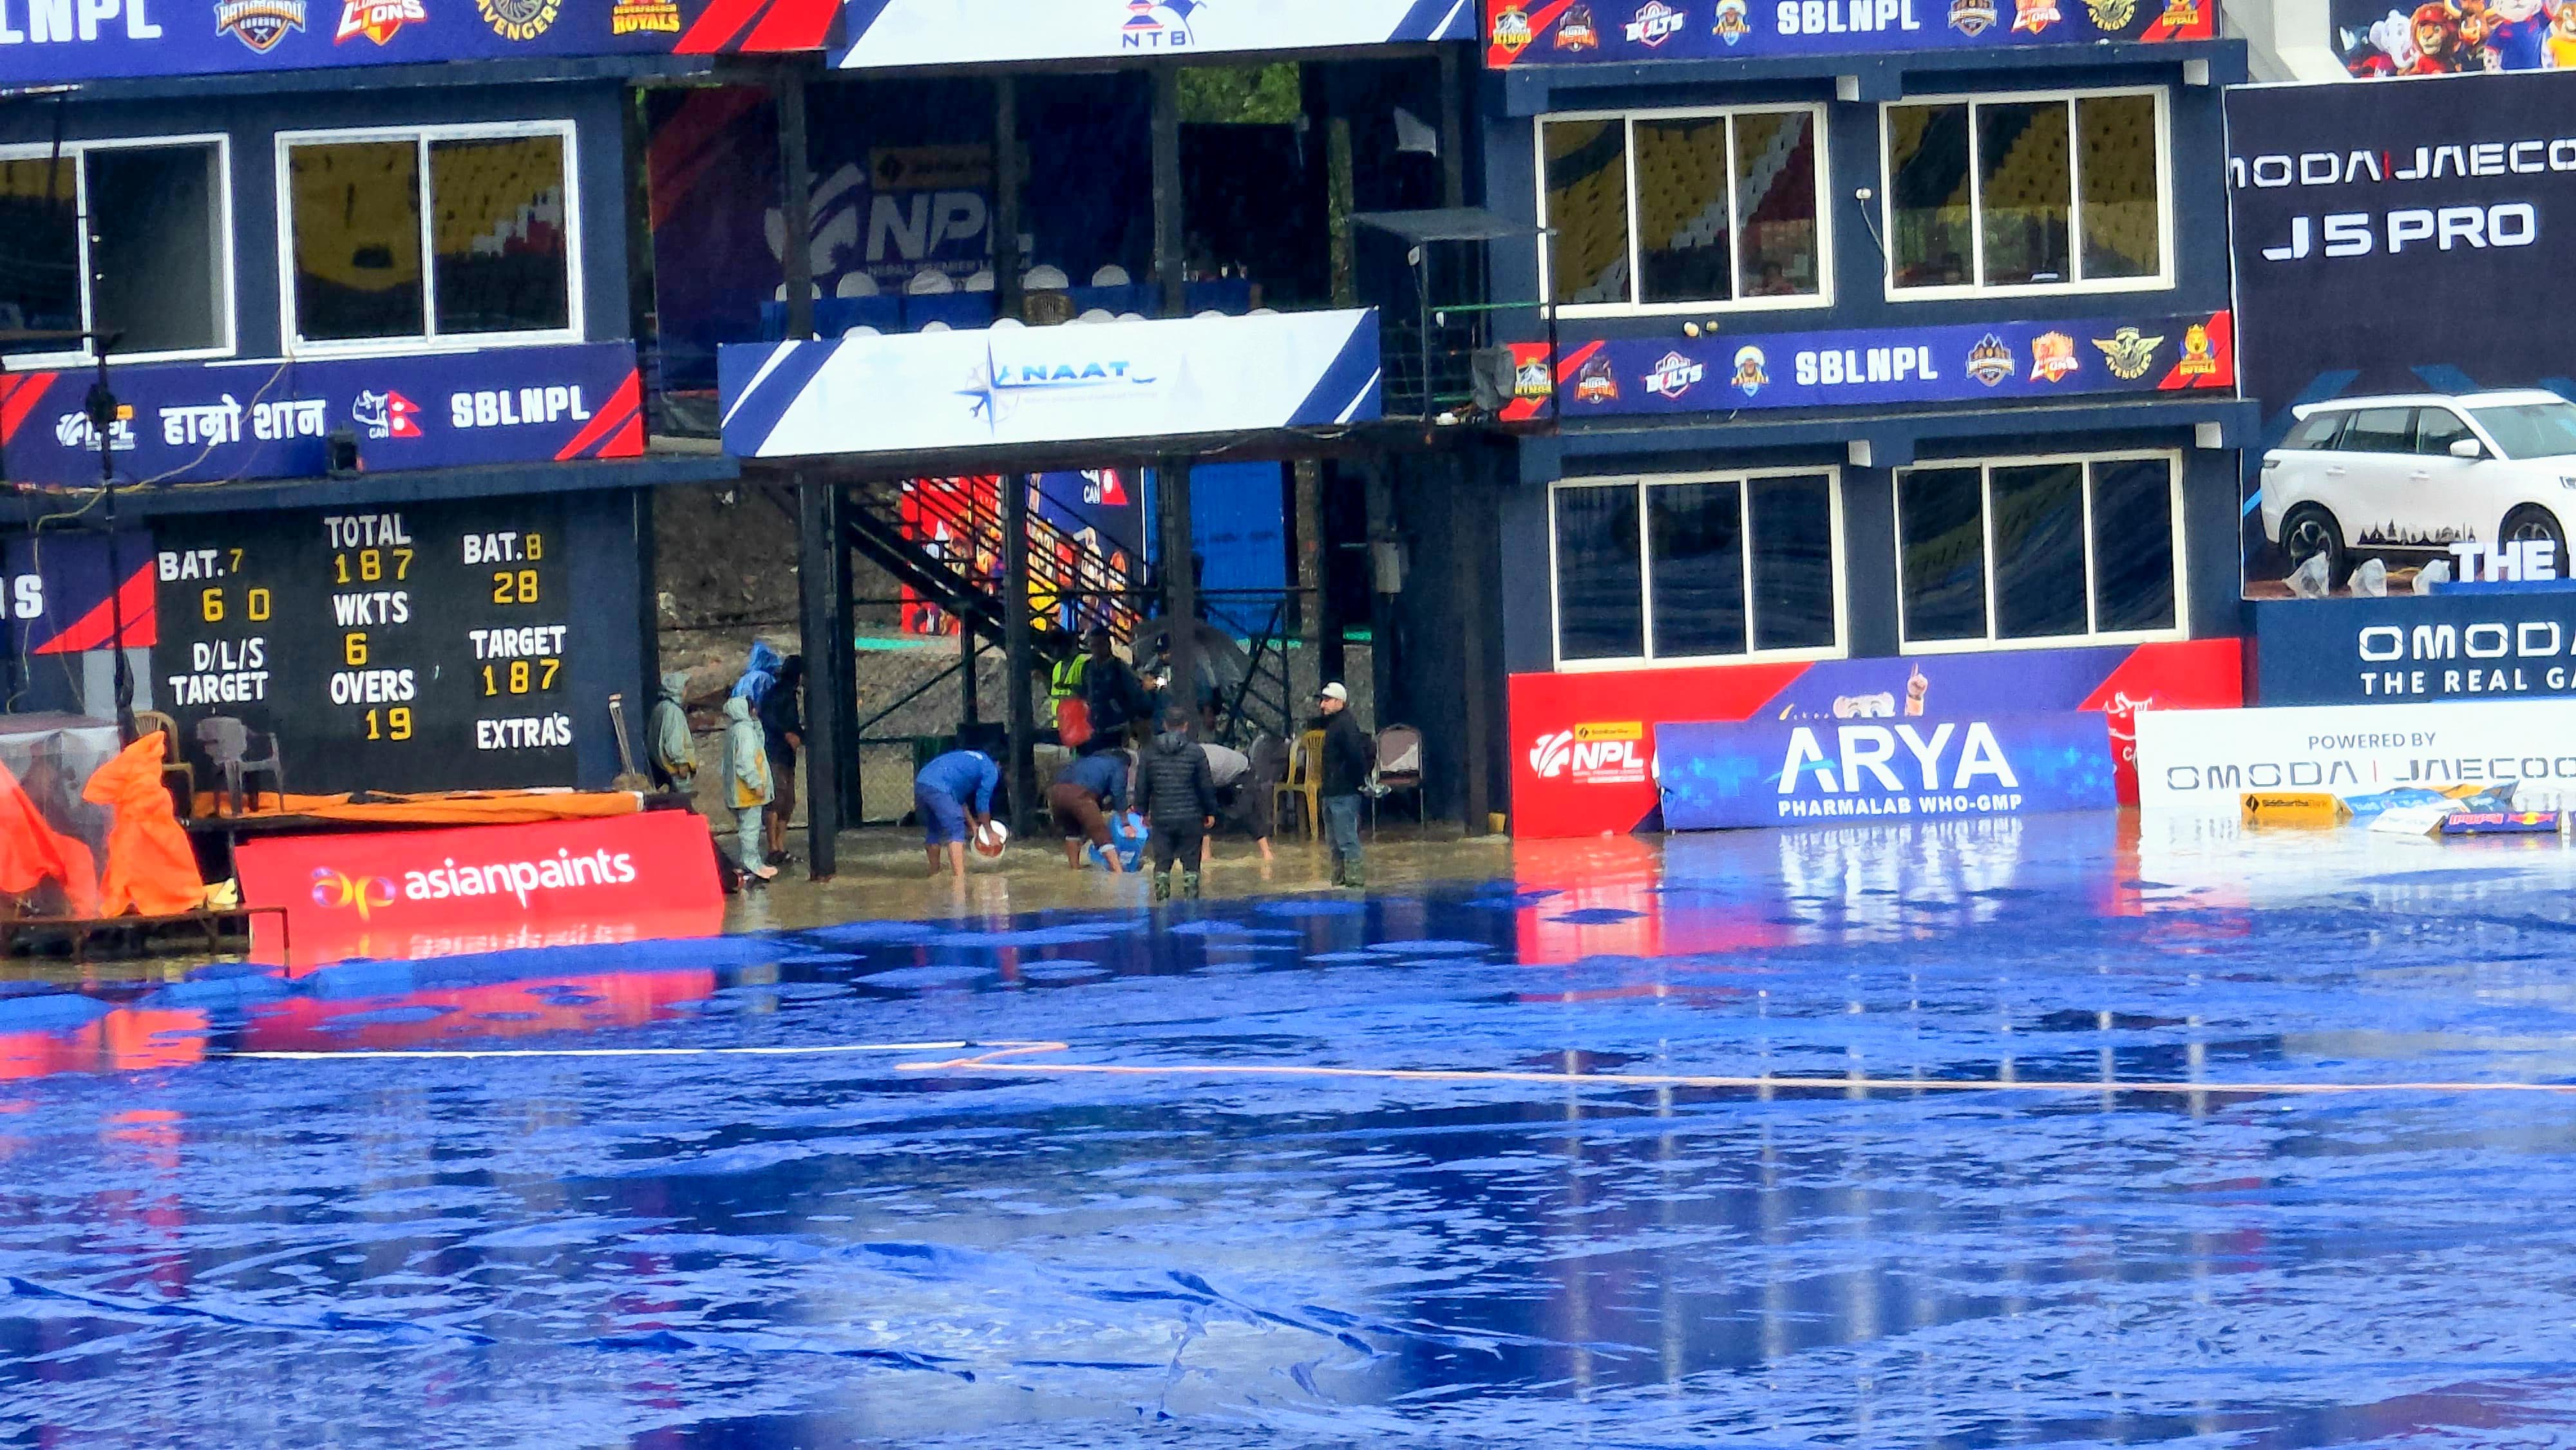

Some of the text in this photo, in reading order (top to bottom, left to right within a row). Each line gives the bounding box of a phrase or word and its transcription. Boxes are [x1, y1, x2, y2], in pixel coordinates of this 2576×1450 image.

[1777, 0, 1920, 35] SBLNPL
[1122, 30, 1186, 48] NTB
[2387, 203, 2535, 254] PRO
[1023, 361, 1129, 381] NAAT
[1795, 346, 1938, 385] SBLNPL
[254, 400, 326, 440] शान
[451, 386, 590, 428] SBLNPL
[325, 514, 412, 549] TOTAL
[463, 532, 541, 565] BAT. 8
[158, 548, 243, 581] BAT. 7
[2449, 540, 2556, 583] THE
[0, 574, 43, 619] S
[493, 569, 538, 603] 28
[333, 591, 408, 626] WKTS
[193, 637, 264, 672] D/L/S
[345, 632, 368, 665] 6
[469, 625, 567, 659] TARGET
[2359, 621, 2576, 661] OMOD
[169, 671, 269, 706] TARGET
[330, 669, 415, 705] OVERS
[2360, 667, 2576, 695] THE REAL G
[365, 707, 413, 740] 19
[2309, 732, 2436, 750] POWERED BY
[1572, 741, 1643, 771] NPL
[1778, 721, 2018, 794] ARYA
[2167, 760, 2358, 791] OMODA
[1778, 794, 2022, 816] PHARMALAB WHO-GMP
[404, 848, 636, 909] asianpaints
